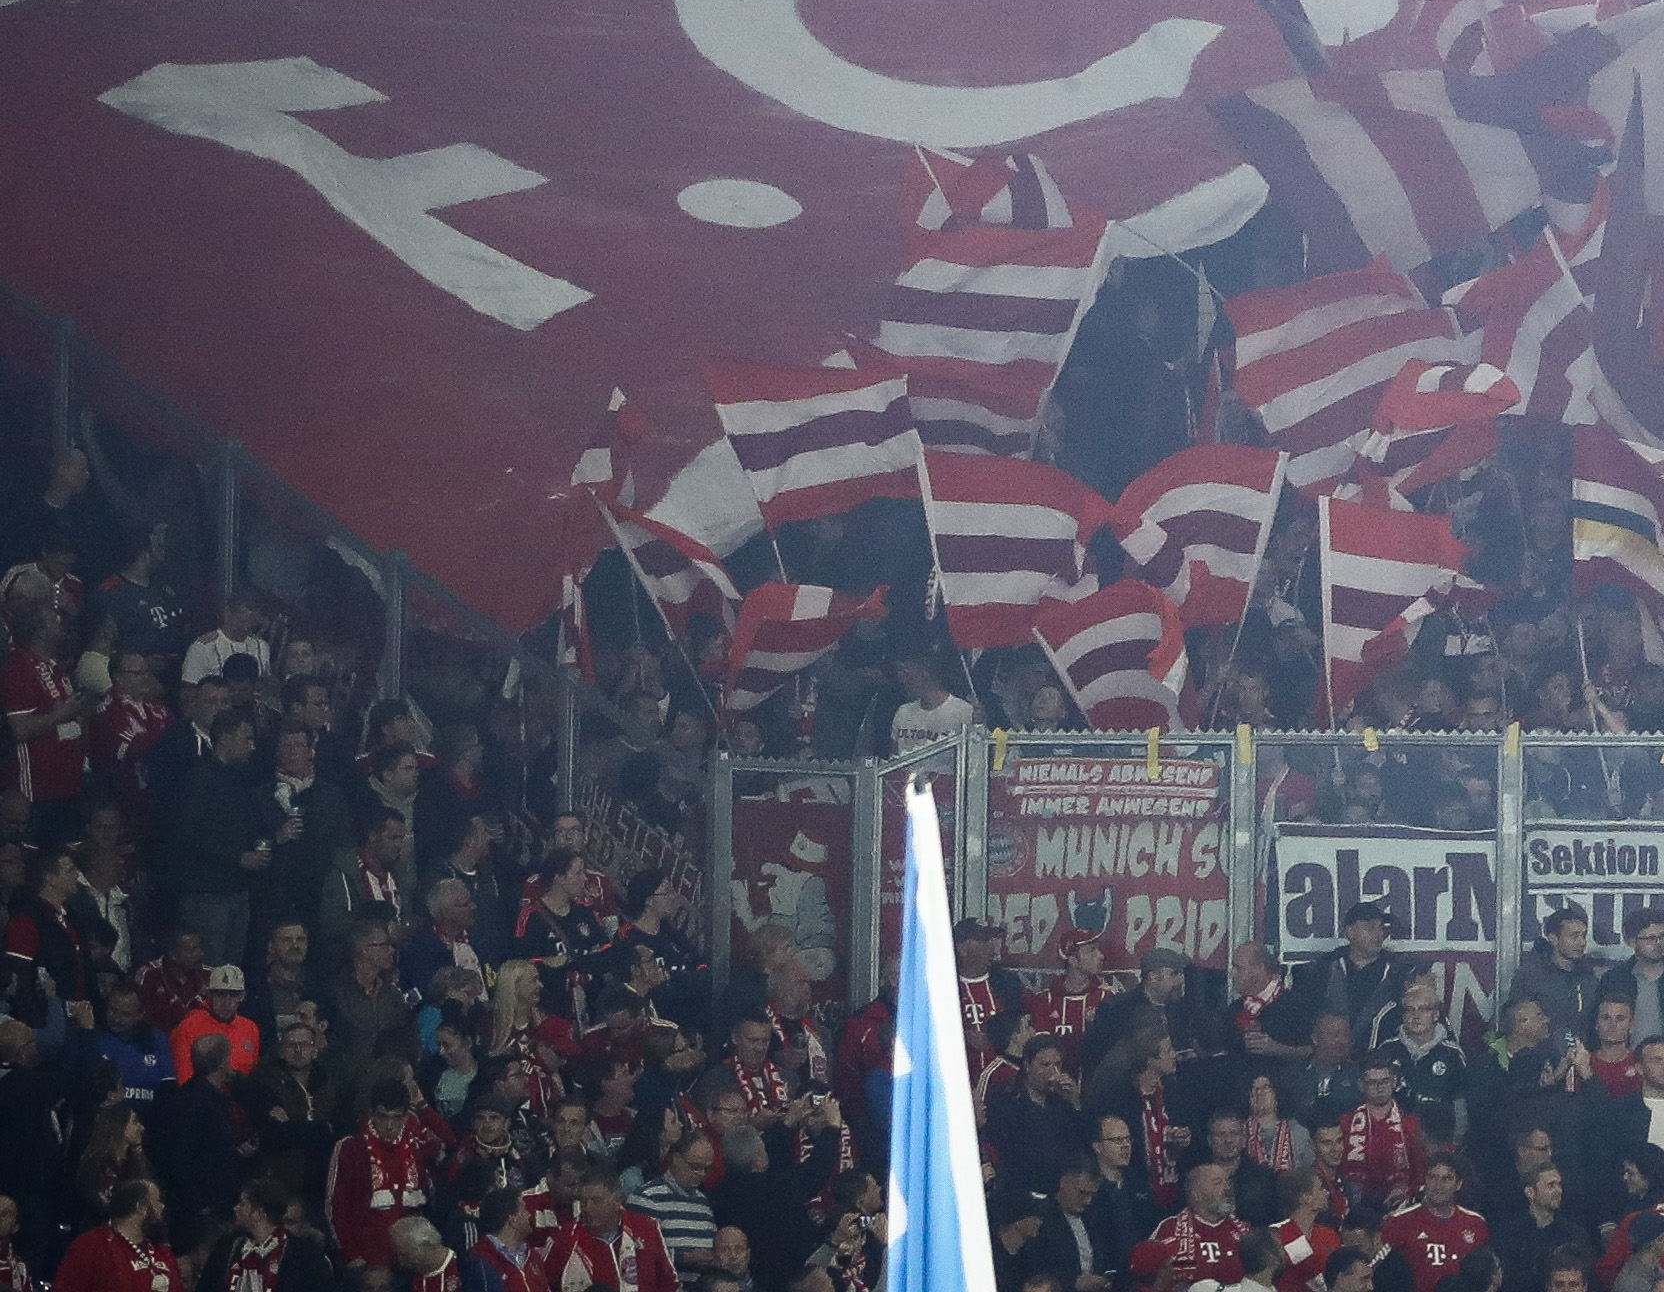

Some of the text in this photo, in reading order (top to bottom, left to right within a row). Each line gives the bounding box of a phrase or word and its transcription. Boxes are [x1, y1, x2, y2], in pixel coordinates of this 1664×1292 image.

[1018, 763, 1104, 784] NIEMALS
[1018, 797, 1211, 818] IMMER ANWESEND
[1529, 838, 1659, 880] Sektion
